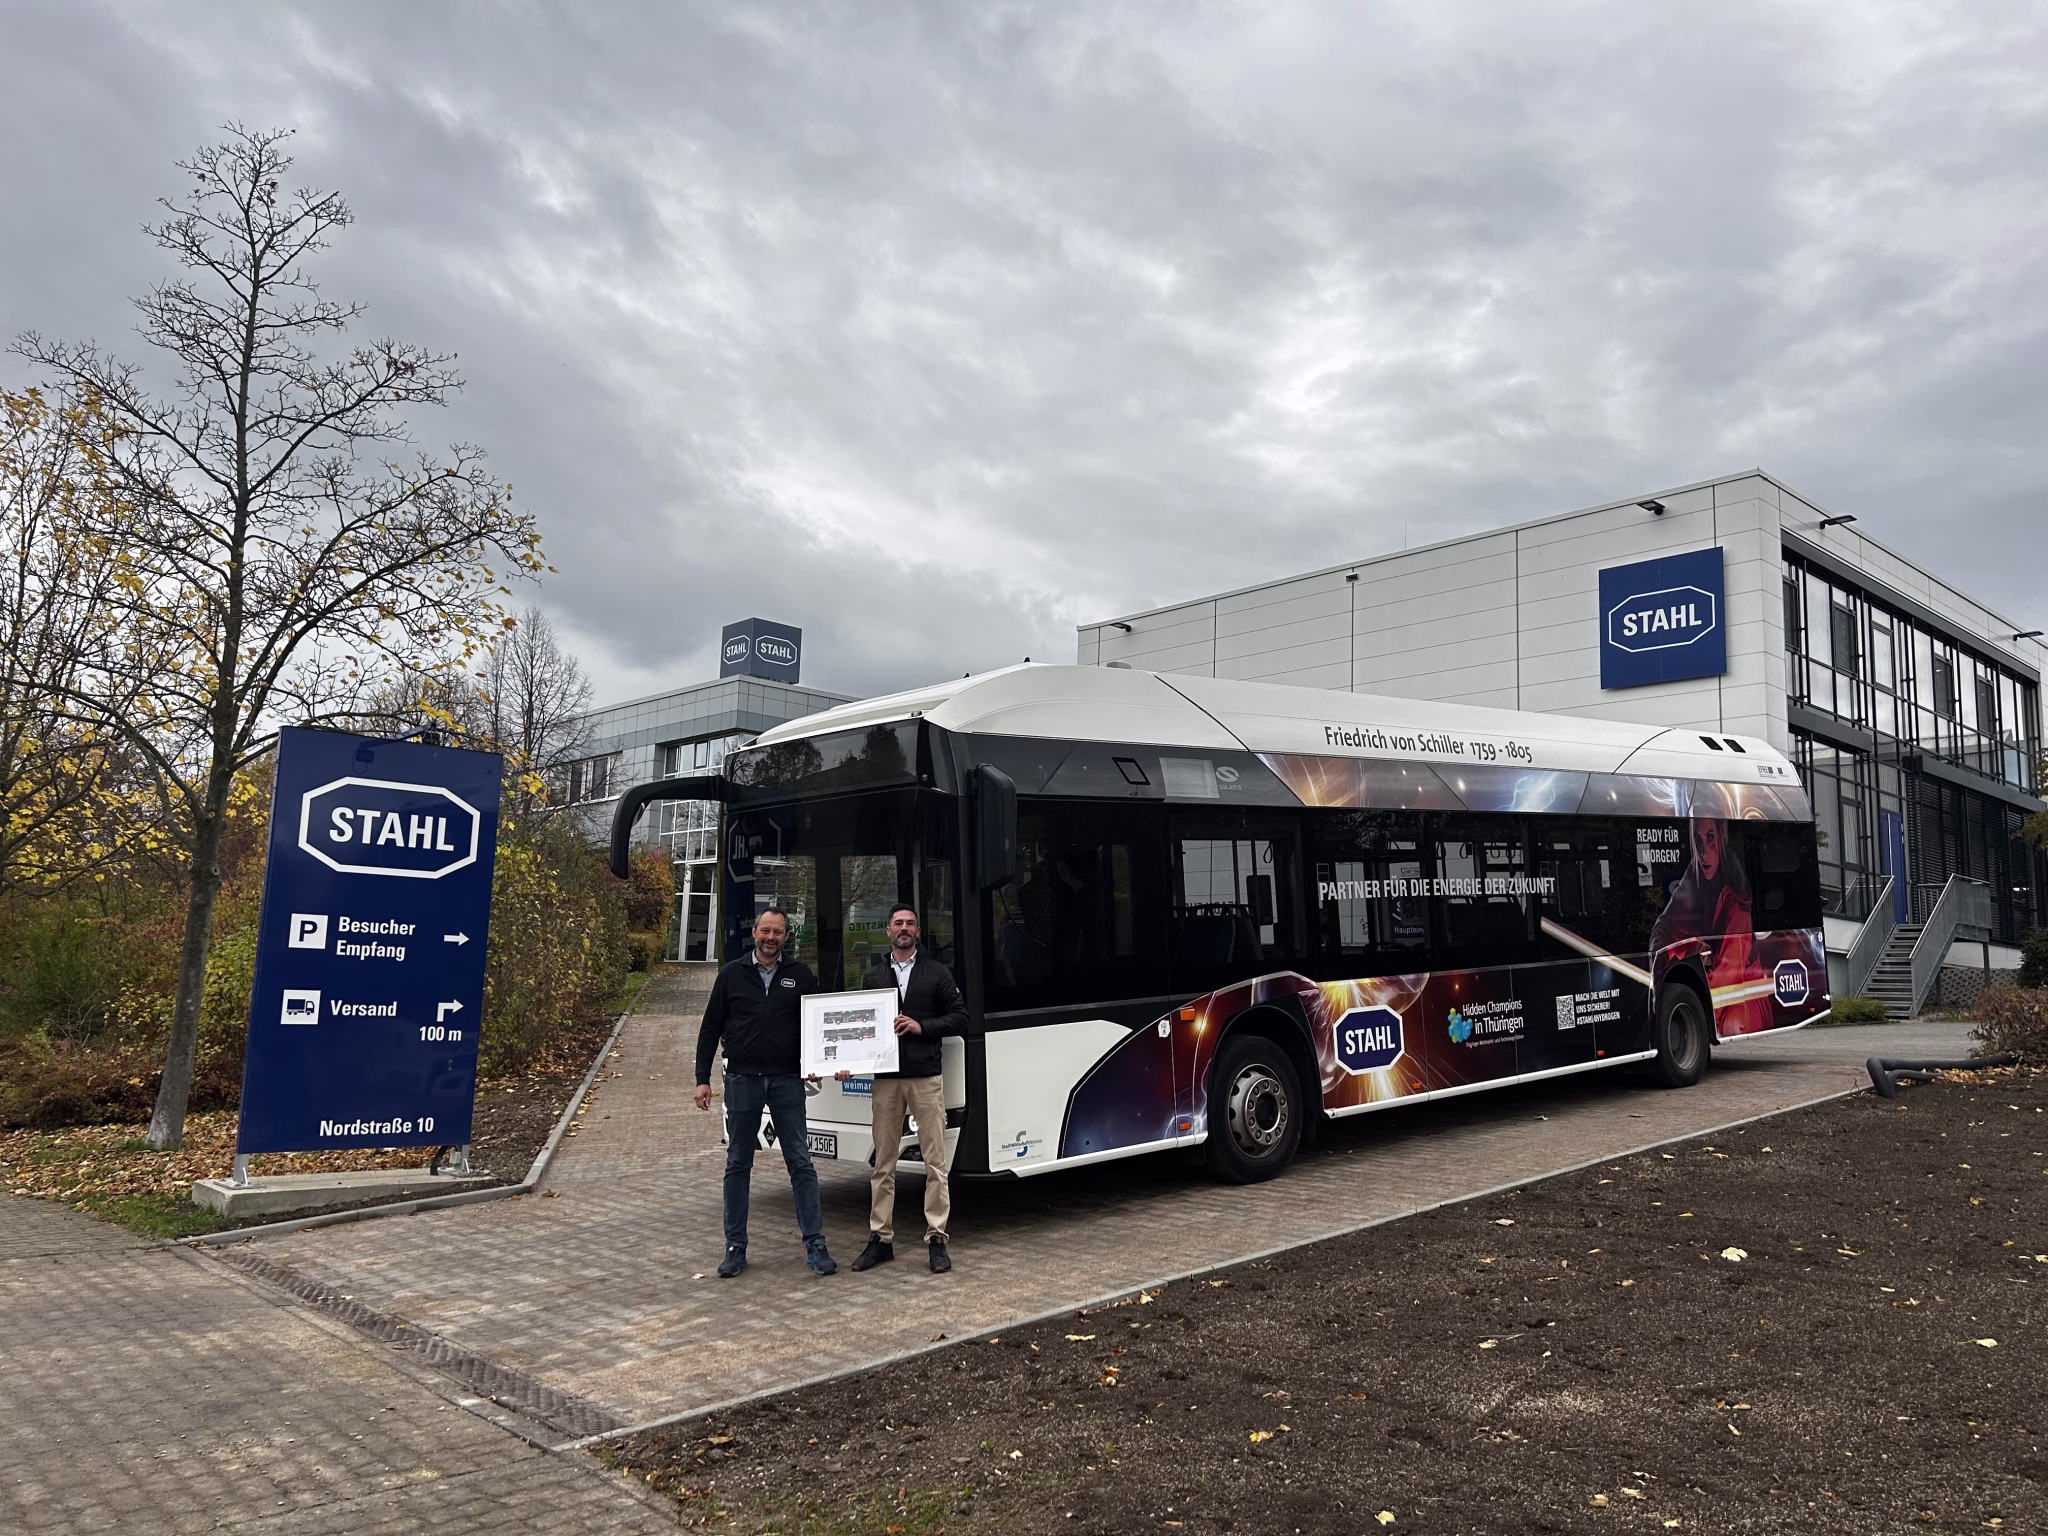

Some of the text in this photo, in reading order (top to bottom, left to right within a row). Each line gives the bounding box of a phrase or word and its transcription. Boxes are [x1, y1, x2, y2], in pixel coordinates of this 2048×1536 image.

[1623, 603, 1702, 636] STAHL
[726, 642, 746, 657] STAHL
[760, 642, 792, 659] STAHL
[1324, 726, 1386, 749] Friedrich
[1390, 735, 1416, 751] von
[1418, 733, 1464, 754] Schiller
[1470, 742, 1496, 761] 1759
[1505, 741, 1532, 763] 1805
[329, 806, 454, 851] STAHL
[1636, 826, 1679, 842] READY FÜR
[1642, 849, 1680, 863] MORGEN?
[1319, 875, 1555, 900] PARTNER FÜR DIE ENERGIE DER ZUKUNFT
[298, 916, 416, 942] P Besucher
[336, 939, 405, 961] Empfang
[1779, 973, 1805, 992] STAHL
[1575, 988, 1620, 1002] MACH DIE WELT MIT
[330, 999, 398, 1017] Versand
[1462, 998, 1523, 1016] Hidden Champions
[1576, 1004, 1587, 1014] UNS
[1474, 1014, 1524, 1034] in Thüringen
[419, 1026, 462, 1041] 100 m
[1345, 1025, 1396, 1055] STAHL
[843, 1080, 872, 1090] weimar
[319, 1117, 434, 1137] Nordstraße 10
[814, 1137, 833, 1153] 150E
